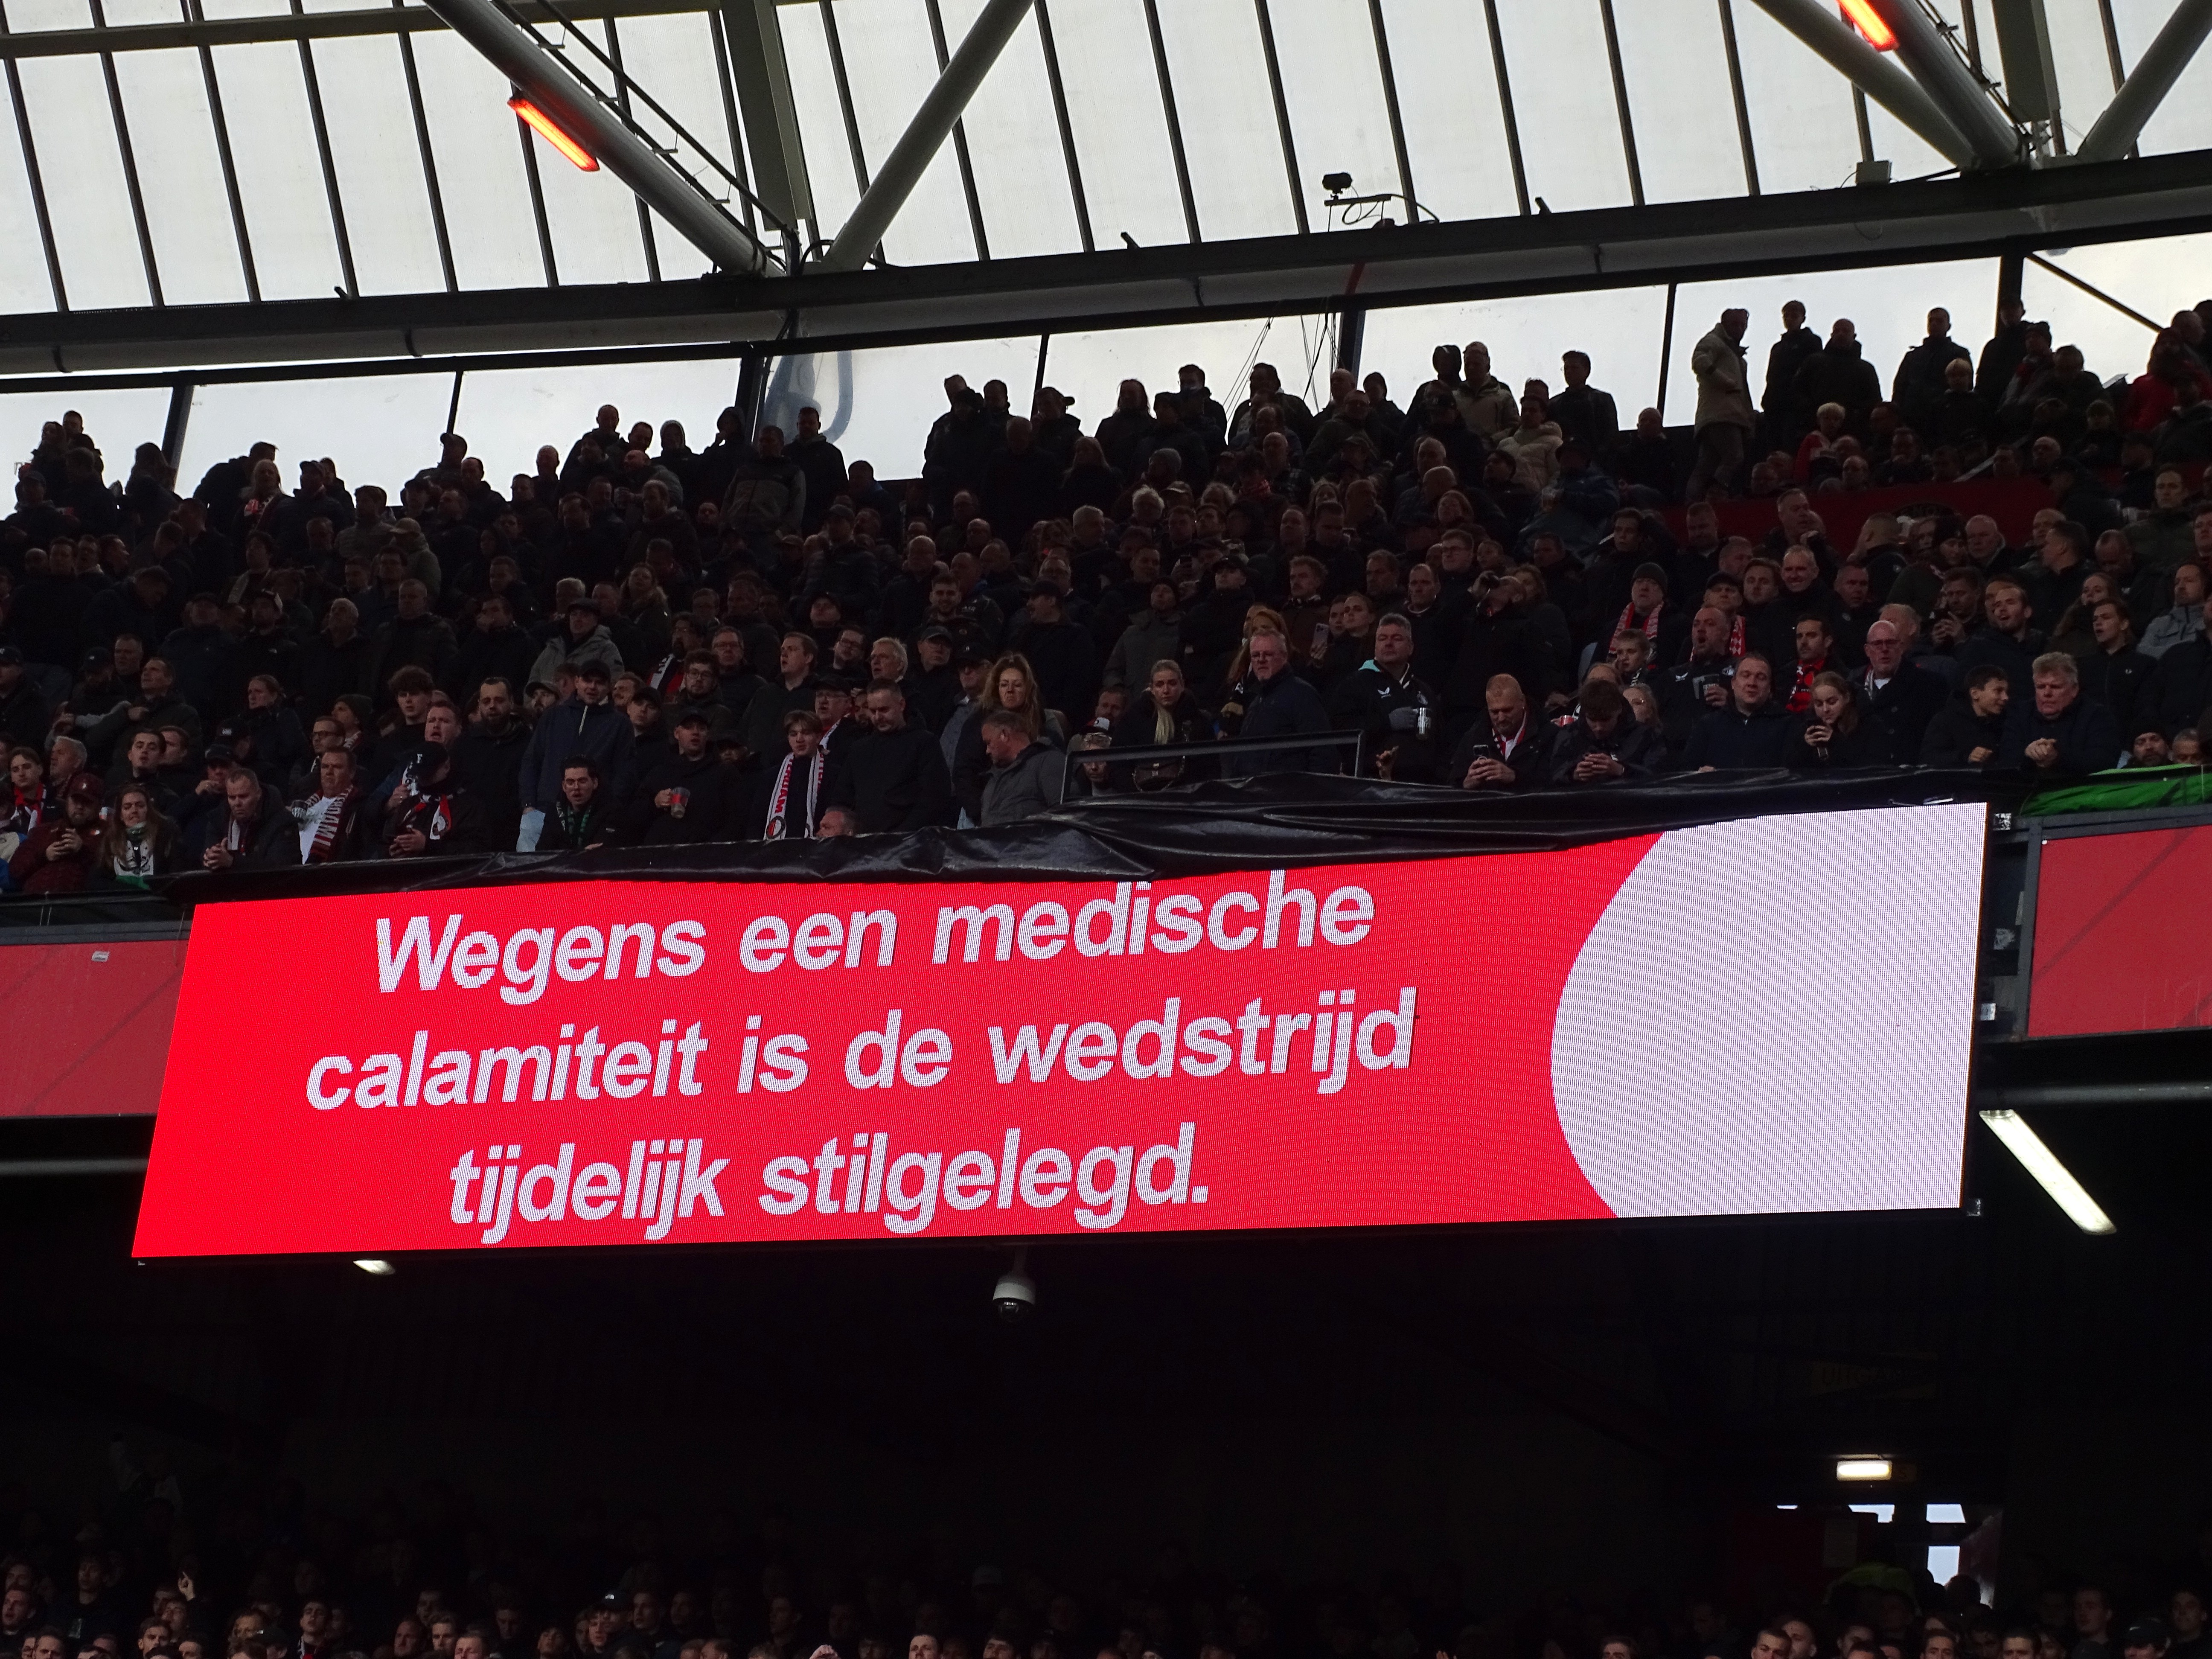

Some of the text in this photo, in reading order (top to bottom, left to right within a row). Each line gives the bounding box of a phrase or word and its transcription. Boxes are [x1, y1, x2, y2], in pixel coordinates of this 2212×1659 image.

[376, 870, 1374, 1005] Wegens een medische
[306, 986, 1416, 1109] calamiteit is de wedstrijd
[449, 1121, 1211, 1244] tijdelijk stilgelegd.
